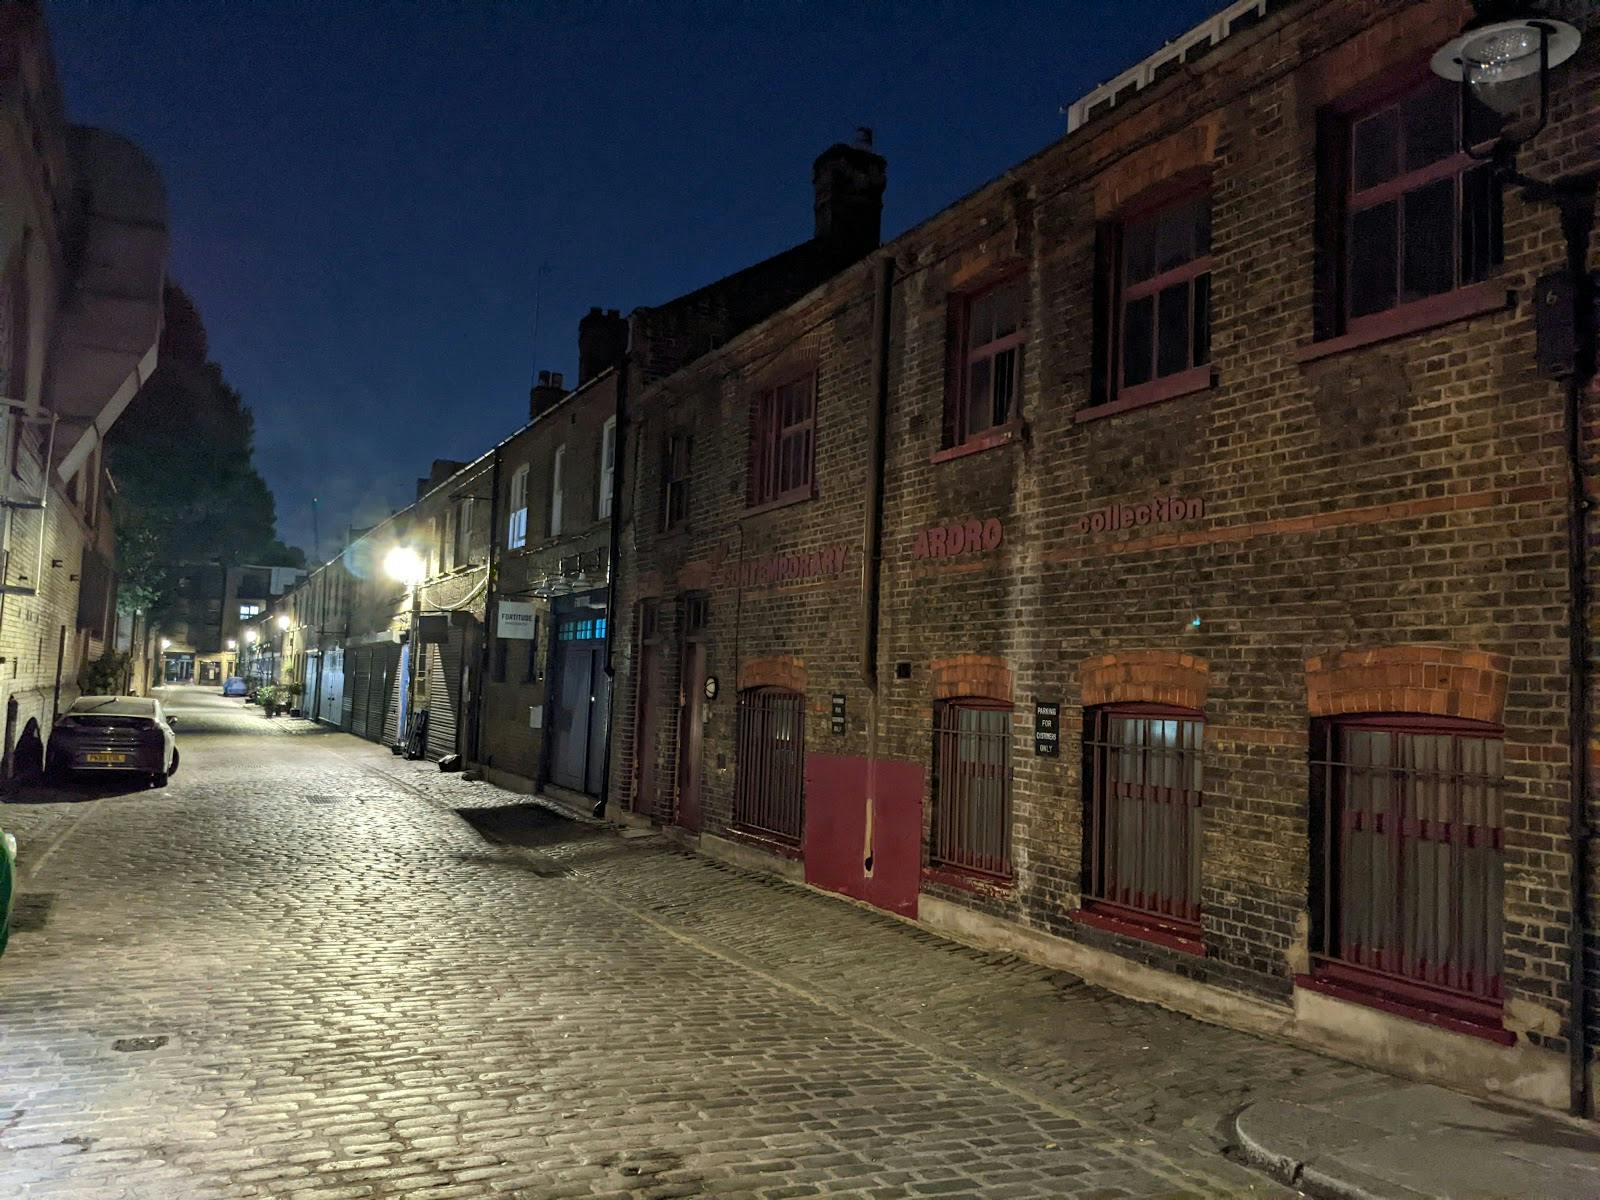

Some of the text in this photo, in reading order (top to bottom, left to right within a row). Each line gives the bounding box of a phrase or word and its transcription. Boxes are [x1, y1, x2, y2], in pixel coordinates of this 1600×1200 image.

[1076, 496, 1206, 533] collection
[501, 613, 532, 621] FORTITUDE
[1037, 706, 1057, 715] PARKING
[1041, 719, 1052, 727] FOR
[1039, 744, 1053, 753] ONLY
